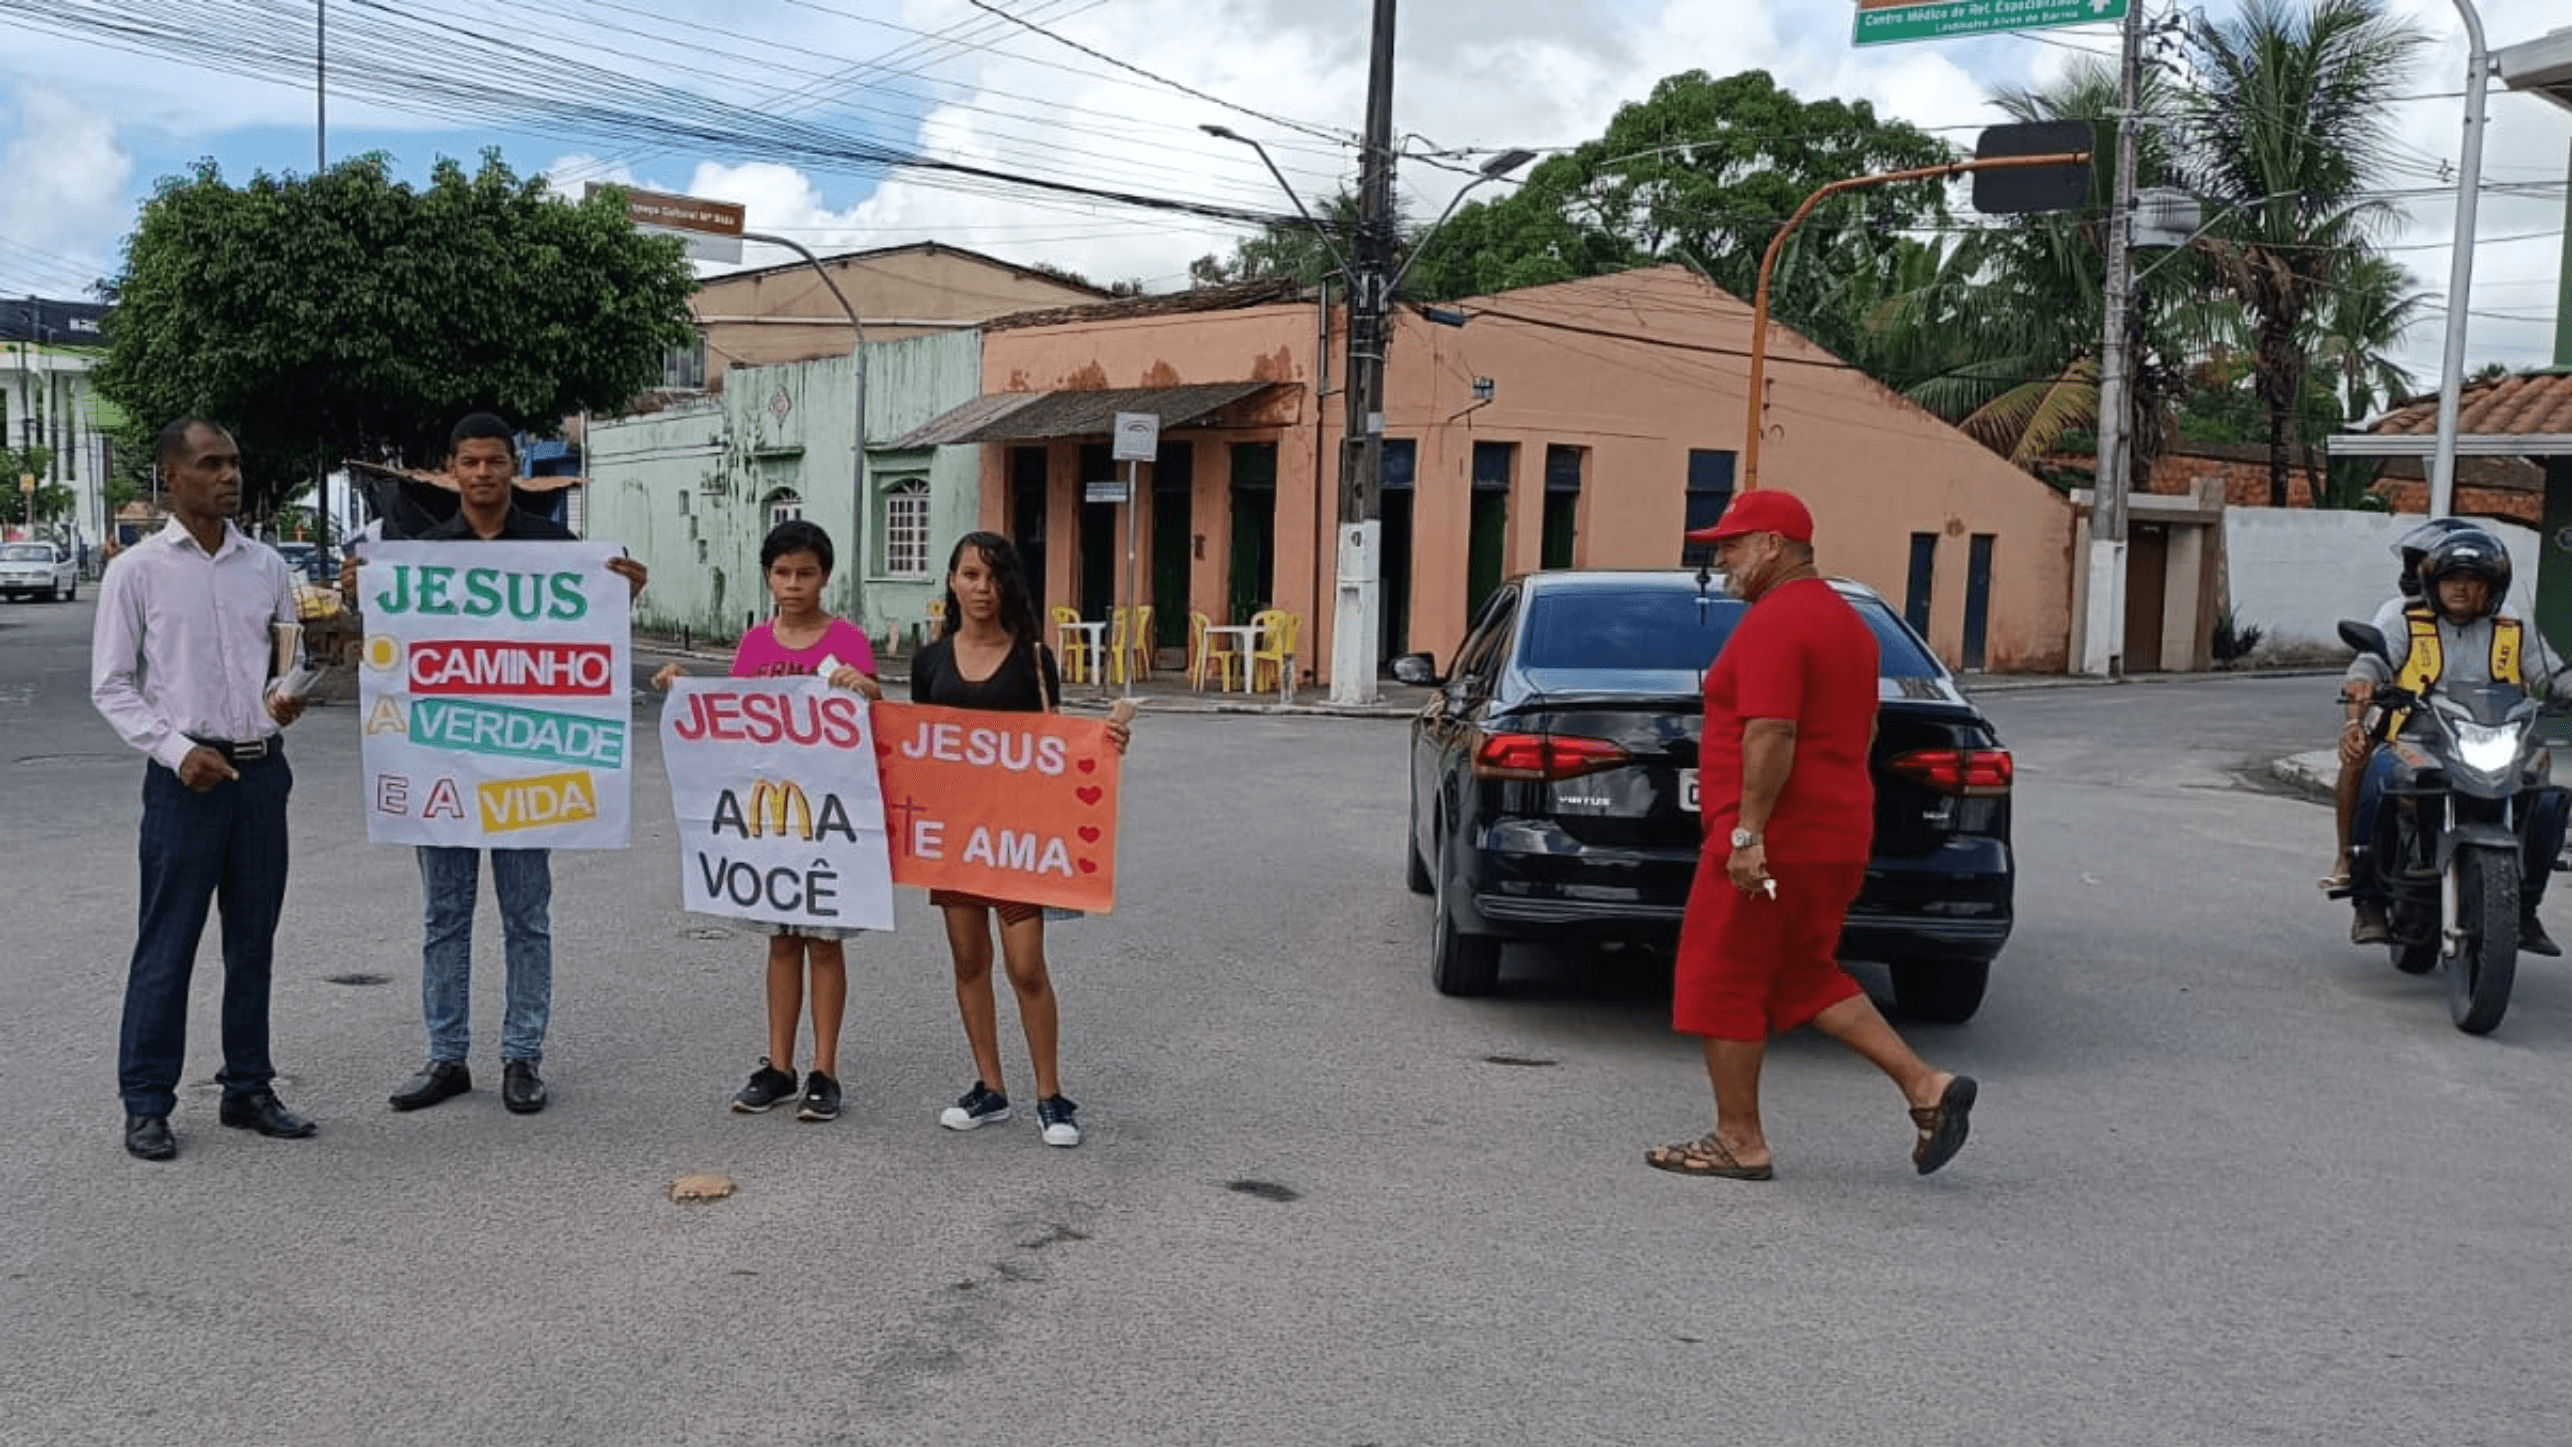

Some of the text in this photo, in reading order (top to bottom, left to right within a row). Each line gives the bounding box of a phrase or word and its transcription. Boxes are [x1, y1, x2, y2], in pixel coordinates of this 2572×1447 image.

[1865, 14, 1904, 26] Centro
[1951, 7, 1965, 17] de
[376, 565, 588, 621] JESUS
[364, 632, 610, 688] O CAMINHO
[366, 694, 626, 764] A VERDADE
[674, 692, 862, 749] JESUS
[902, 722, 1067, 776] JESUS
[376, 774, 597, 825] E A VIDA
[712, 779, 857, 843] AMA
[1559, 796, 1611, 806] VIRTUS
[962, 826, 1074, 877] AMA
[698, 851, 839, 917] VOCÊ
